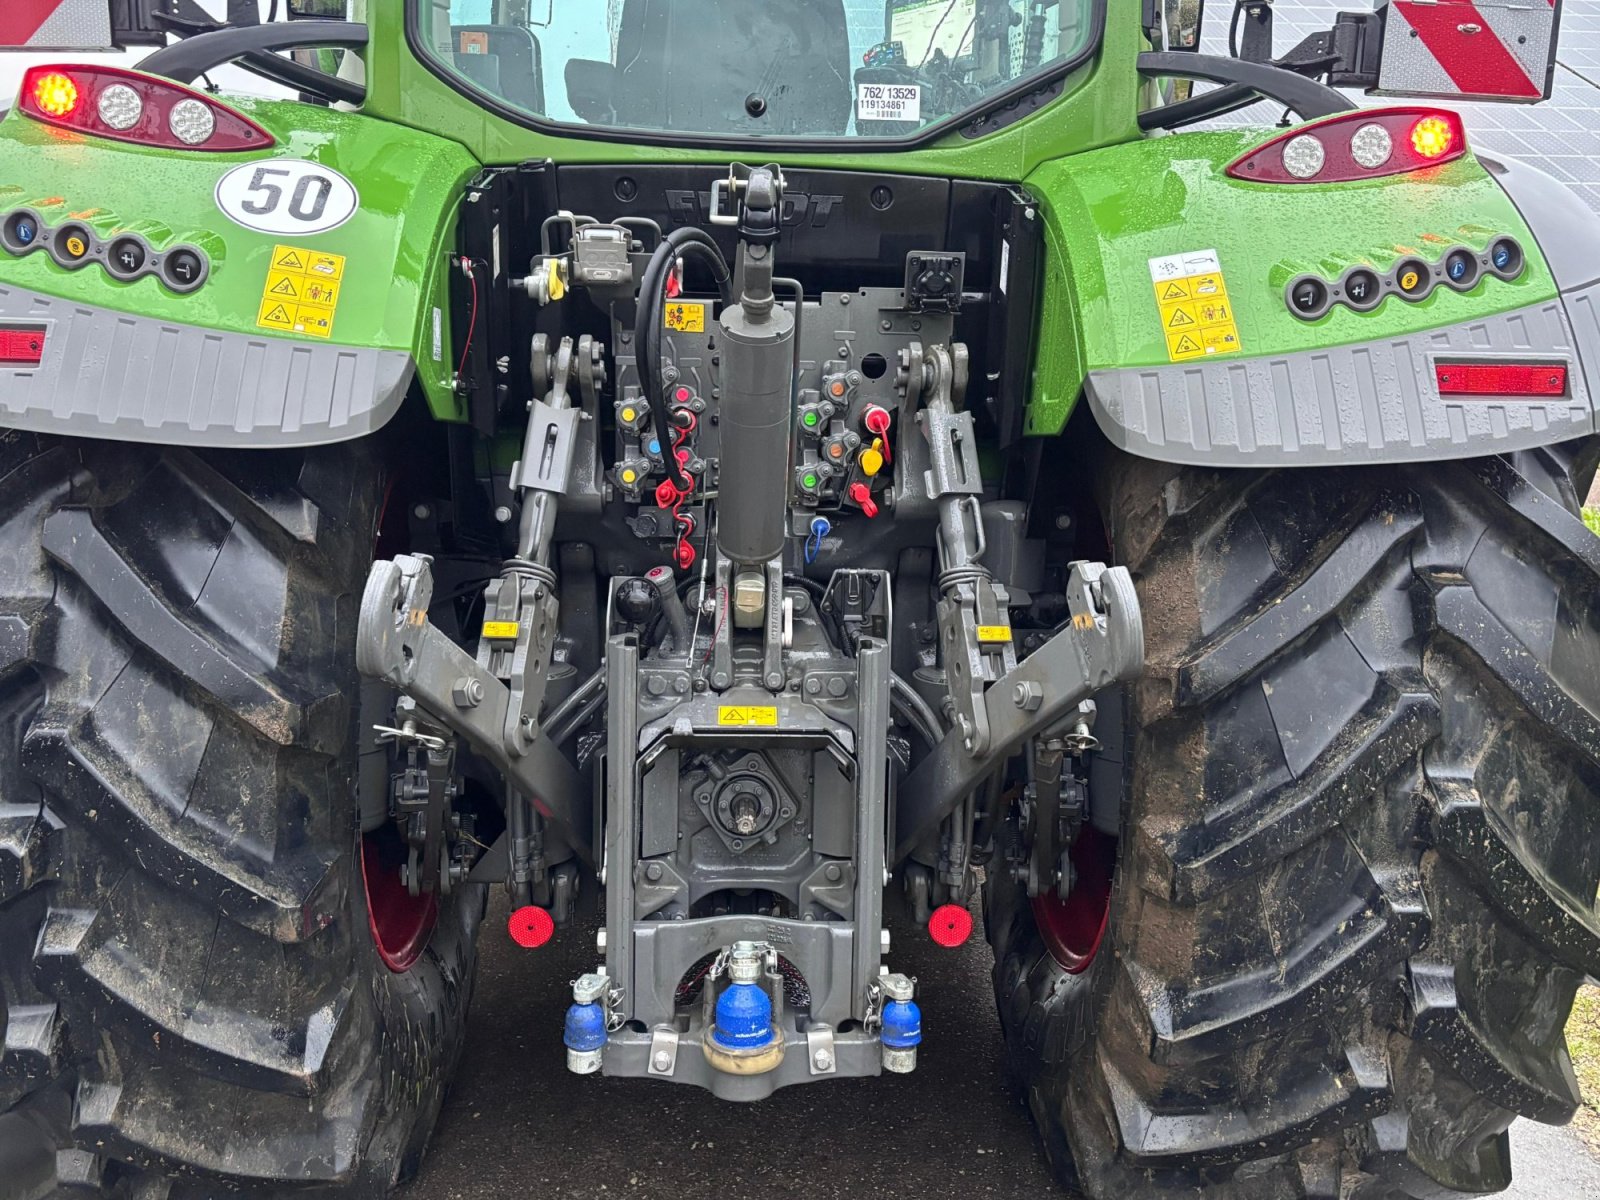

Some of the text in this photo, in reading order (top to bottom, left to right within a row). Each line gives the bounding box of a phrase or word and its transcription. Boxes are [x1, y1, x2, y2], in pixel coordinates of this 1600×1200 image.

[860, 100, 905, 109] 119134861
[241, 168, 333, 222] 50
[665, 189, 845, 228] FEDT
